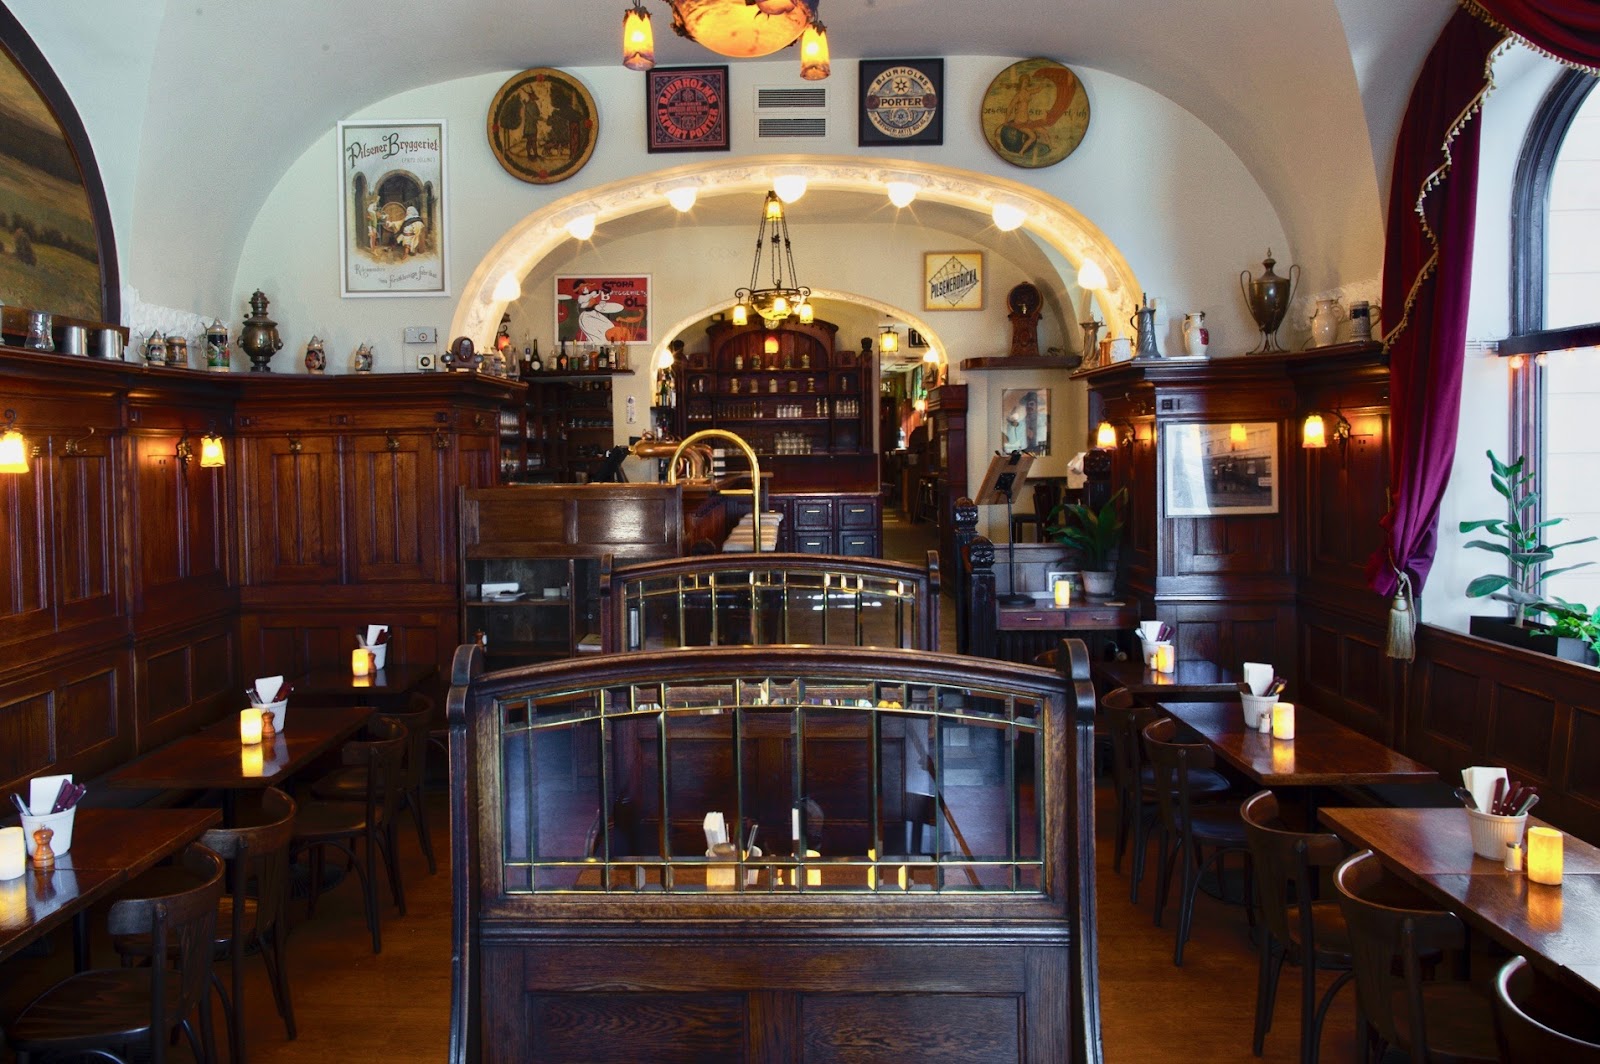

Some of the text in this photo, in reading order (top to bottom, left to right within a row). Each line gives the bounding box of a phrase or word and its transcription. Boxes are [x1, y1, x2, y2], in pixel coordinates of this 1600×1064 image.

[875, 69, 929, 86] BJURHOLMS
[659, 78, 717, 105] BJURHOLMS
[881, 97, 922, 106] PORTER
[658, 108, 688, 140] EXPORT
[689, 108, 719, 139] PORTER
[346, 132, 438, 169] Pilsener Bryggeriet
[624, 295, 647, 308] ÖL
